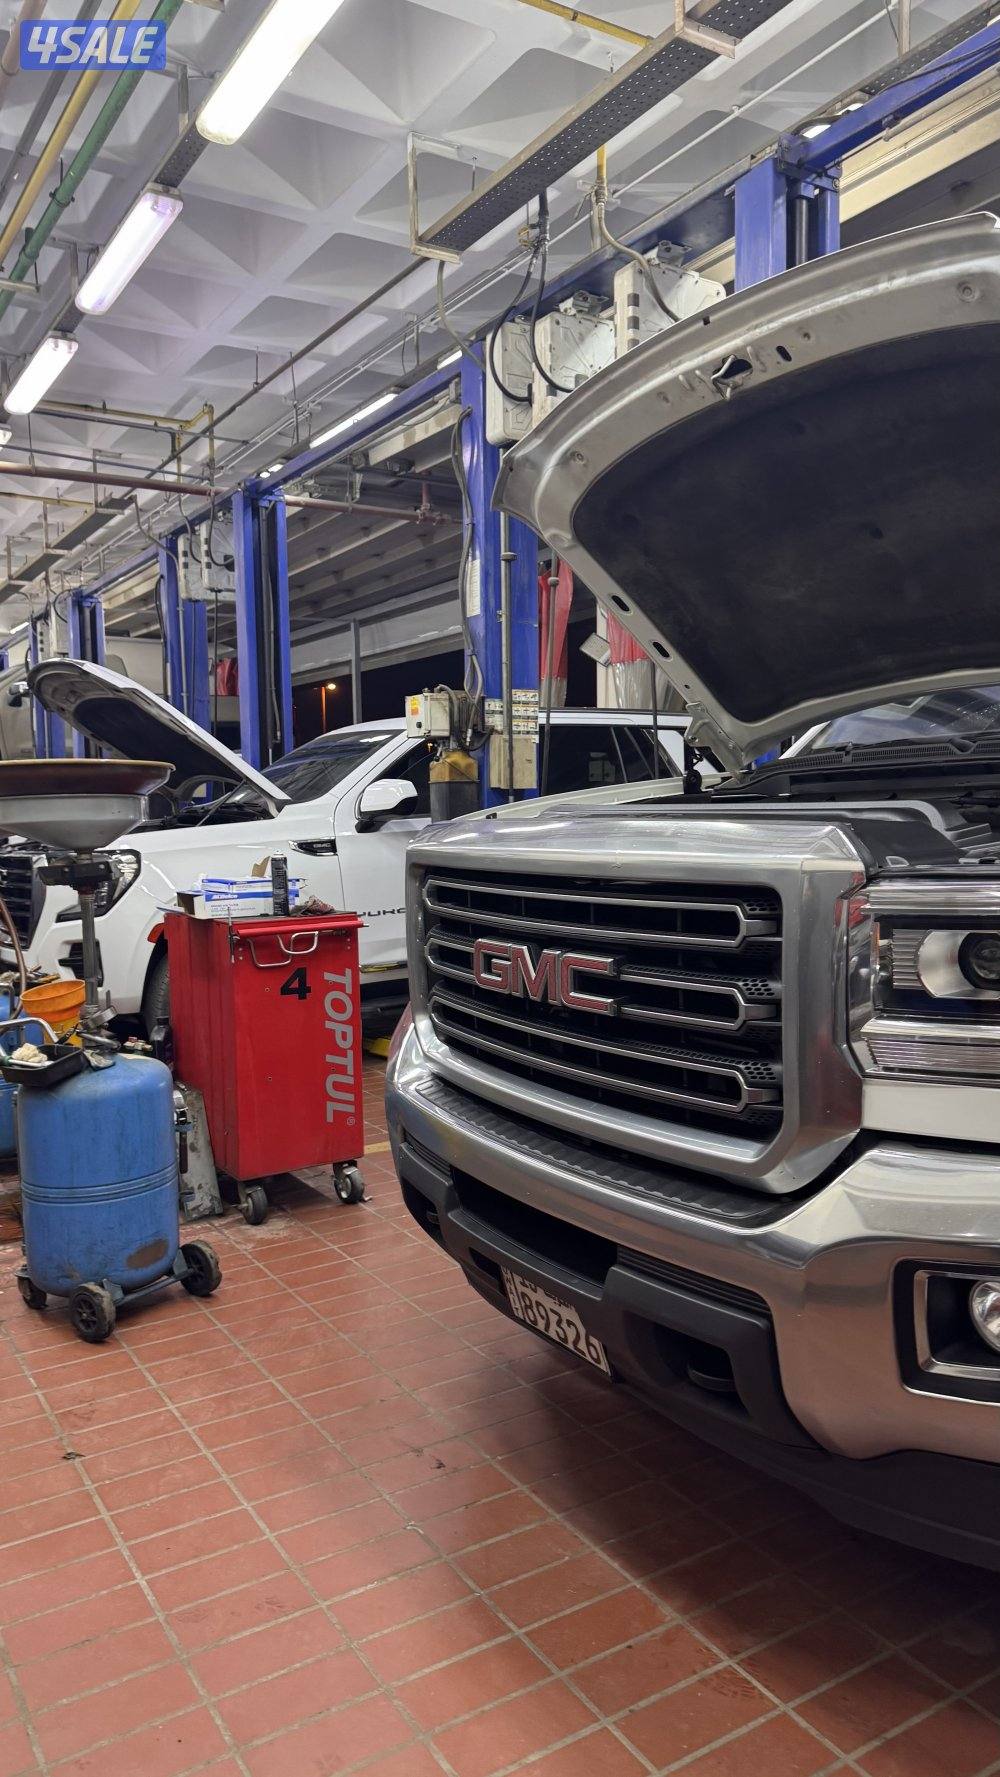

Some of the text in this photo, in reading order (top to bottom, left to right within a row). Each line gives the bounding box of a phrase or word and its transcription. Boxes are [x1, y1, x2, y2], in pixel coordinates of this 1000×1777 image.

[280, 967, 311, 1000] 4
[474, 938, 618, 1017] GMC
[323, 968, 356, 1123] TOPTUL
[521, 1291, 602, 1365] 89326
